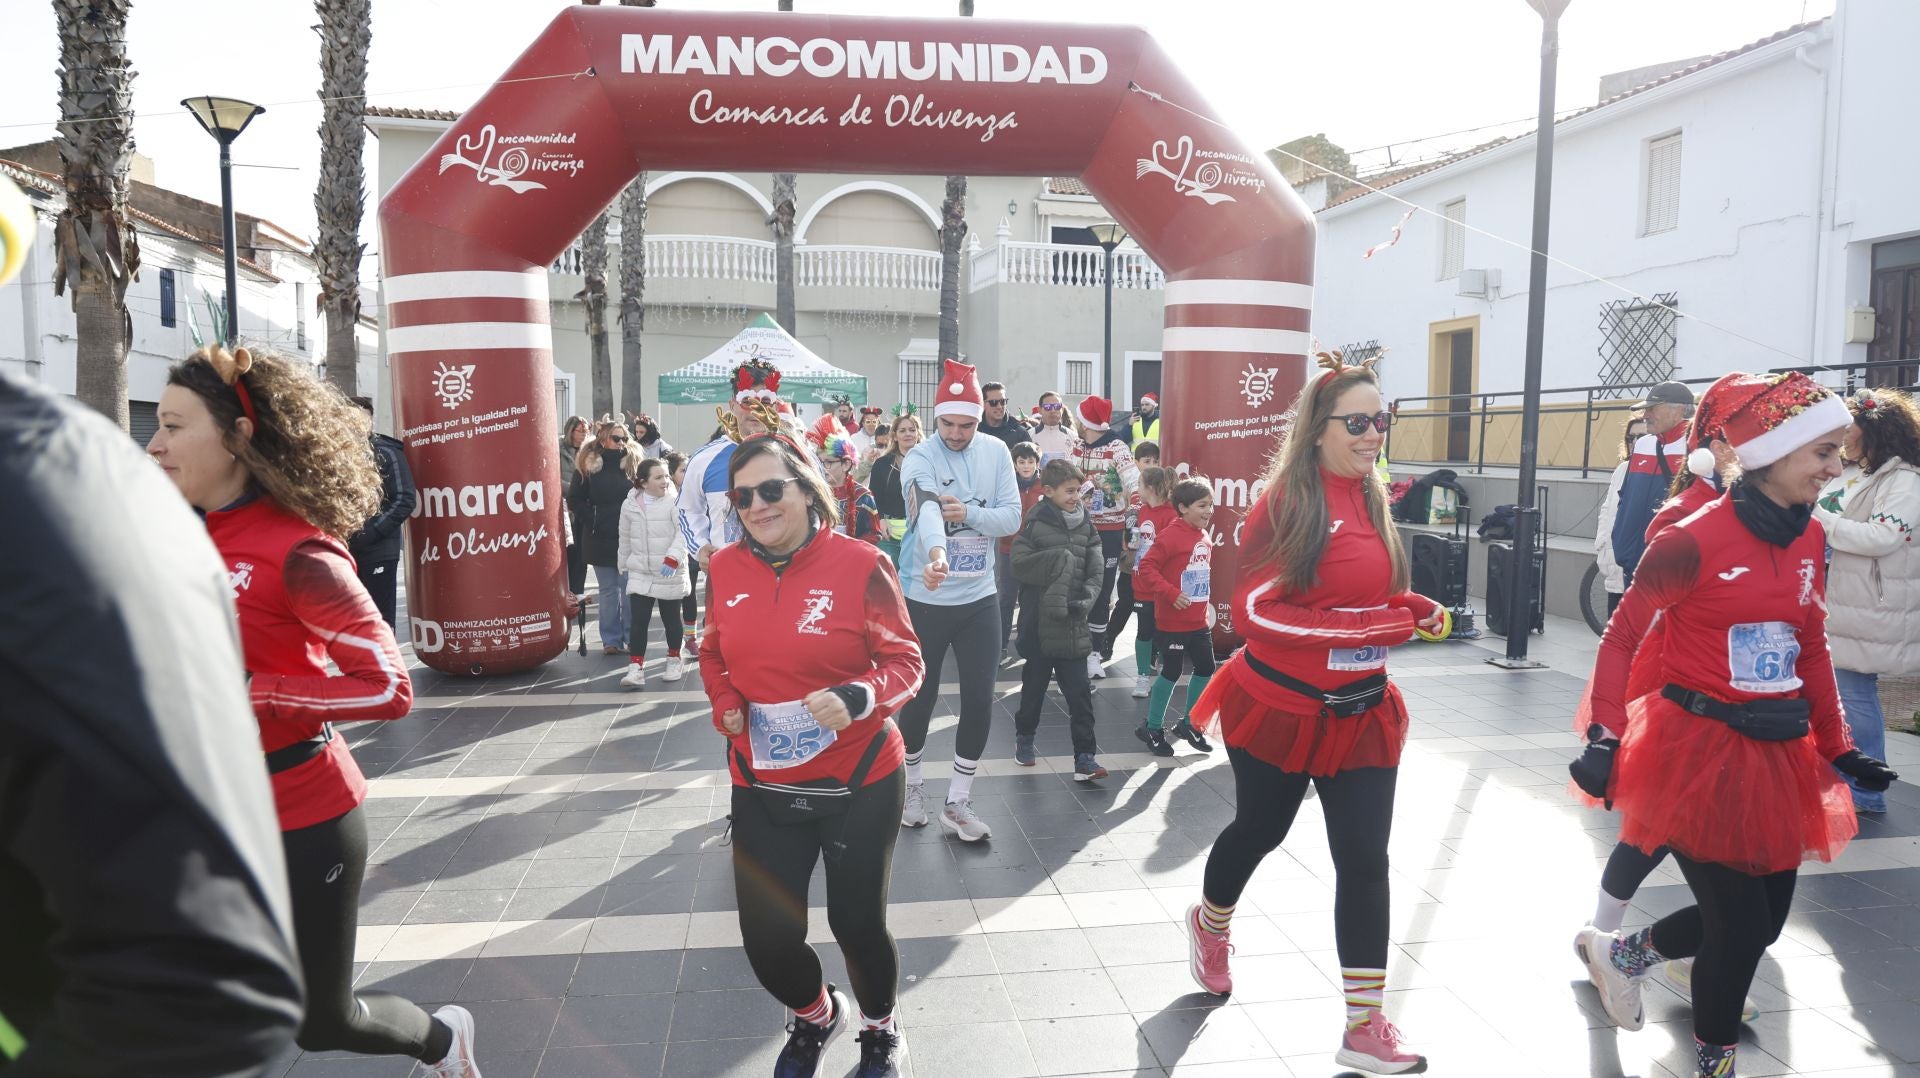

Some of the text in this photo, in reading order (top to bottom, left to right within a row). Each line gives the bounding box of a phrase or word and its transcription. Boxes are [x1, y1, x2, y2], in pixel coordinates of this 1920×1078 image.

[620, 33, 1109, 85] MANCOMUNIDAD
[689, 88, 1019, 143] Comarca de Olivenza
[401, 421, 442, 438] Deportistas
[444, 419, 459, 430] por
[472, 408, 509, 424] Igualdad
[511, 405, 528, 415] Real
[411, 419, 519, 448] entre Mujeres y Hombres!!
[1195, 418, 1244, 430] Deportistas
[1246, 417, 1259, 426] por
[1261, 415, 1268, 423] la
[1207, 432, 1229, 440] entre
[1231, 428, 1263, 438] Mujeres
[1264, 427, 1269, 436] y
[420, 524, 548, 564] de Olivenza
[948, 553, 986, 572] 123
[444, 611, 551, 629] DINAMIZACIÓN DEPORTIVA
[1217, 612, 1229, 620] DE
[444, 631, 455, 639] DE
[457, 627, 521, 639] EXTREMADURA
[768, 725, 822, 761] 25
